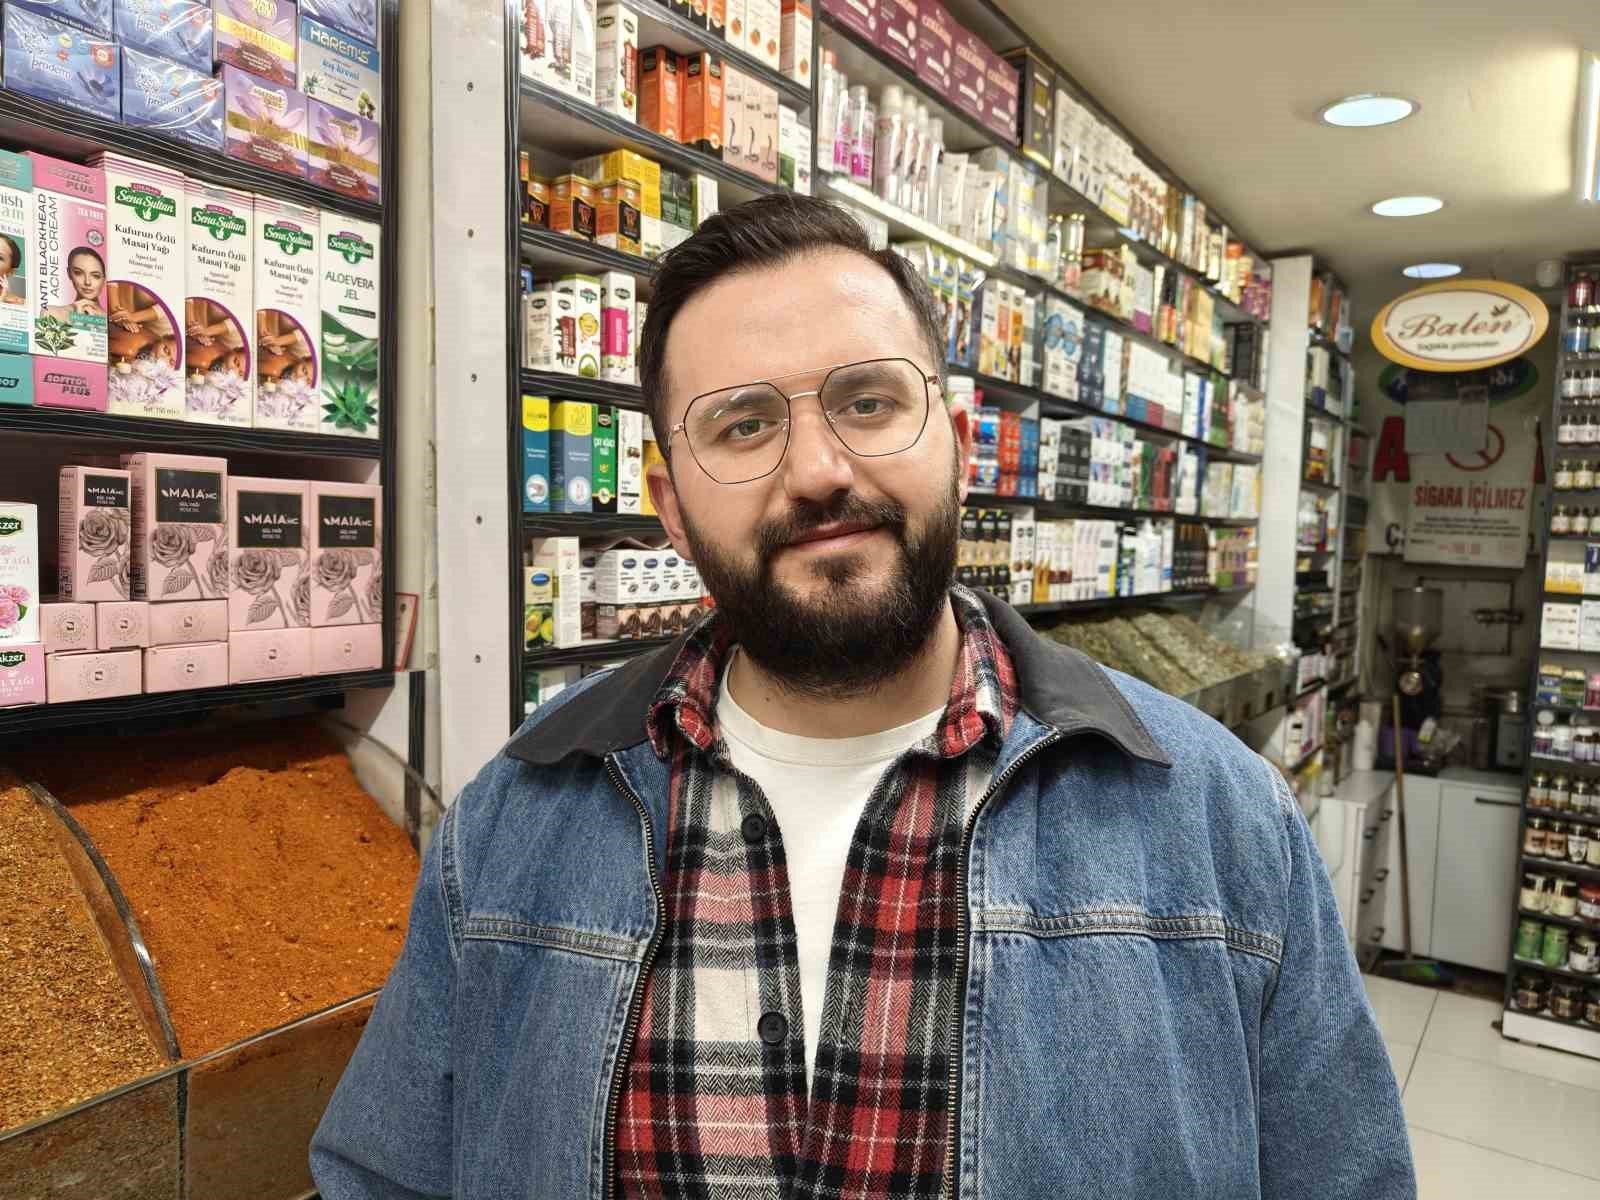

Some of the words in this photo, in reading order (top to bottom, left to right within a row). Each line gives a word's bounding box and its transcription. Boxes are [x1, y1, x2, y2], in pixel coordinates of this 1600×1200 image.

[117, 189, 142, 205] Sena
[143, 195, 174, 213] Sultan
[48, 196, 59, 252] CREAM
[193, 211, 217, 226] Sena
[217, 216, 245, 233] Sultan
[38, 193, 49, 276] BLACKHEAD
[115, 224, 153, 240] Kafurun
[265, 226, 287, 240] Sena
[121, 237, 149, 252] Masaj
[191, 243, 227, 258] Kafurun
[198, 256, 223, 269] Masaj
[49, 255, 60, 298] ACNE
[39, 280, 49, 311] ANTI
[343, 288, 361, 301] JEL
[1398, 312, 1513, 338] Balen
[62, 384, 92, 397] PLUS
[92, 486, 116, 494] MAIA
[169, 487, 206, 499] MAIA
[1415, 480, 1463, 507] SİGARA
[1467, 480, 1527, 514] İÇİLMEZ
[250, 514, 286, 525] MAIA
[330, 515, 362, 527] MAIA
